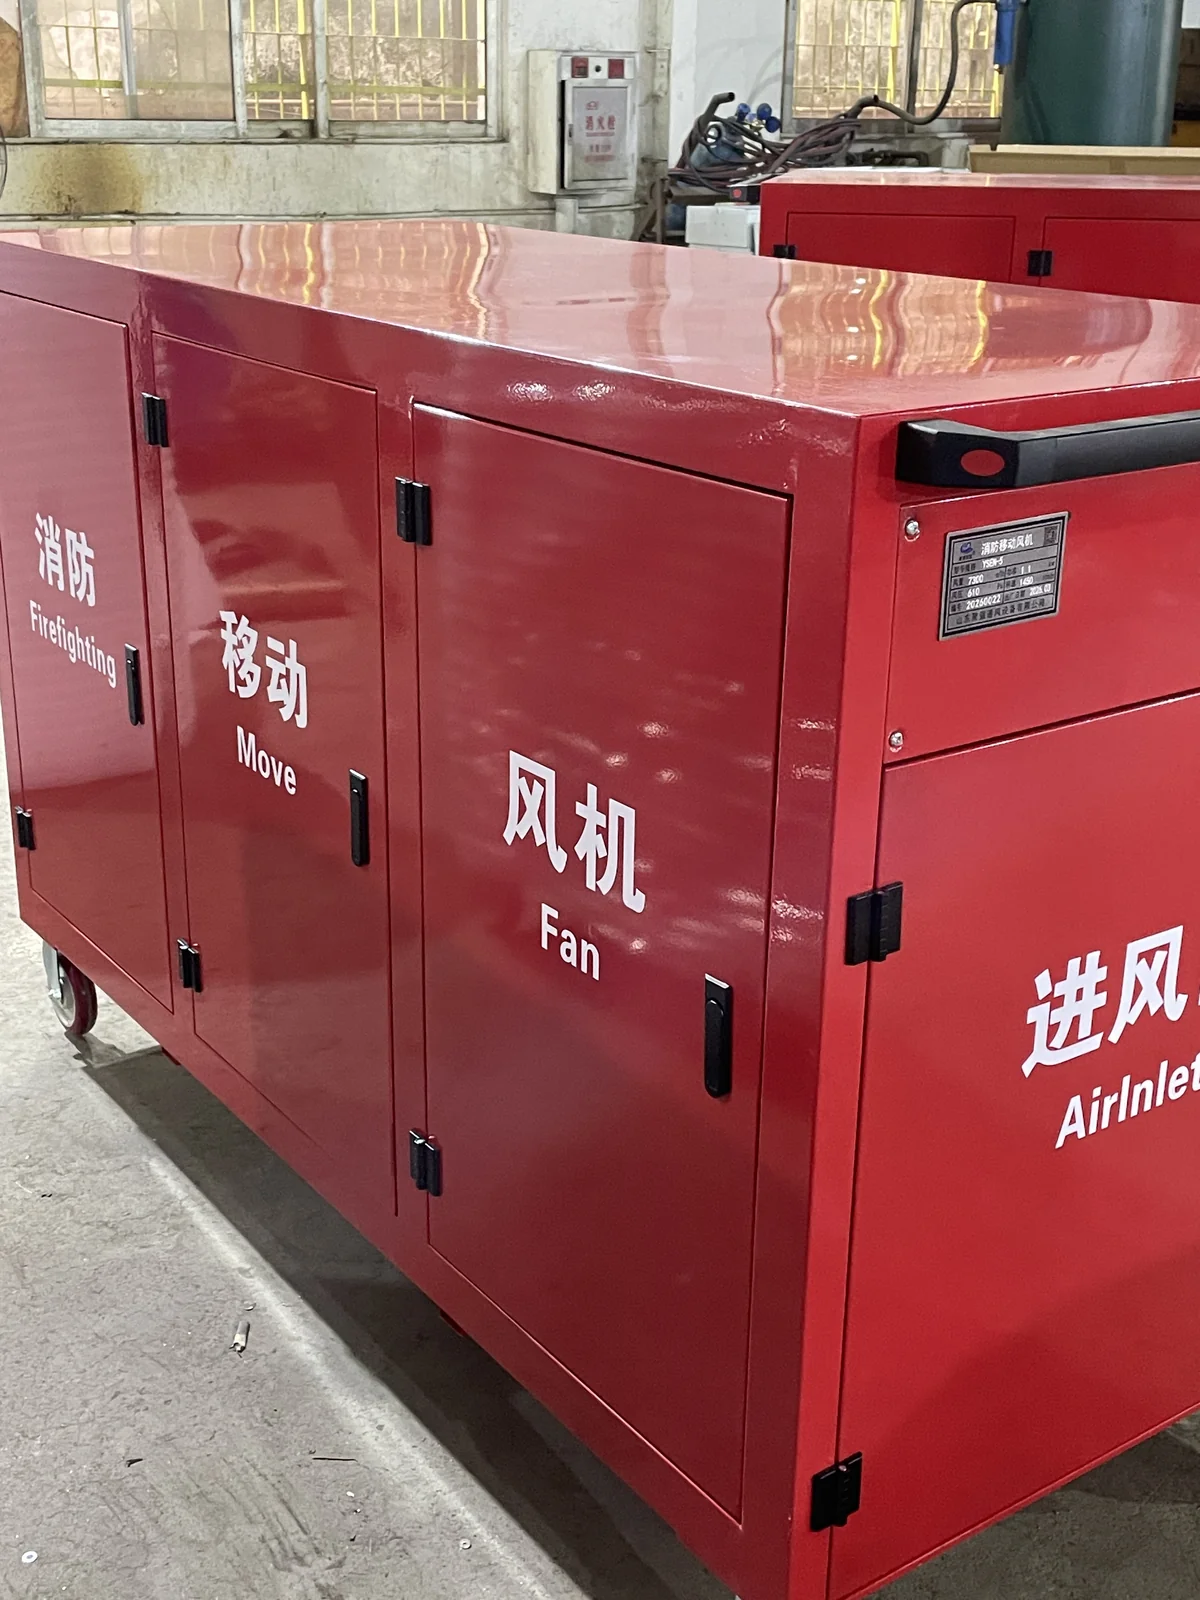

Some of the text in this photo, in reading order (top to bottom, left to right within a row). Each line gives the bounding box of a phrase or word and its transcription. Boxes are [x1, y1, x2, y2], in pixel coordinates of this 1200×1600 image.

[35, 512, 96, 607] 消防
[981, 534, 1033, 555] 消防移动风机
[966, 594, 1001, 610] 20260022
[967, 587, 980, 598] 610
[30, 600, 117, 688] Firefighting
[219, 610, 308, 729] 移动
[237, 725, 297, 795] Move
[503, 750, 646, 913] 风机
[541, 902, 600, 981] Fan
[1021, 925, 1200, 1079] 进风
[1055, 1052, 1200, 1149] AirInlet
